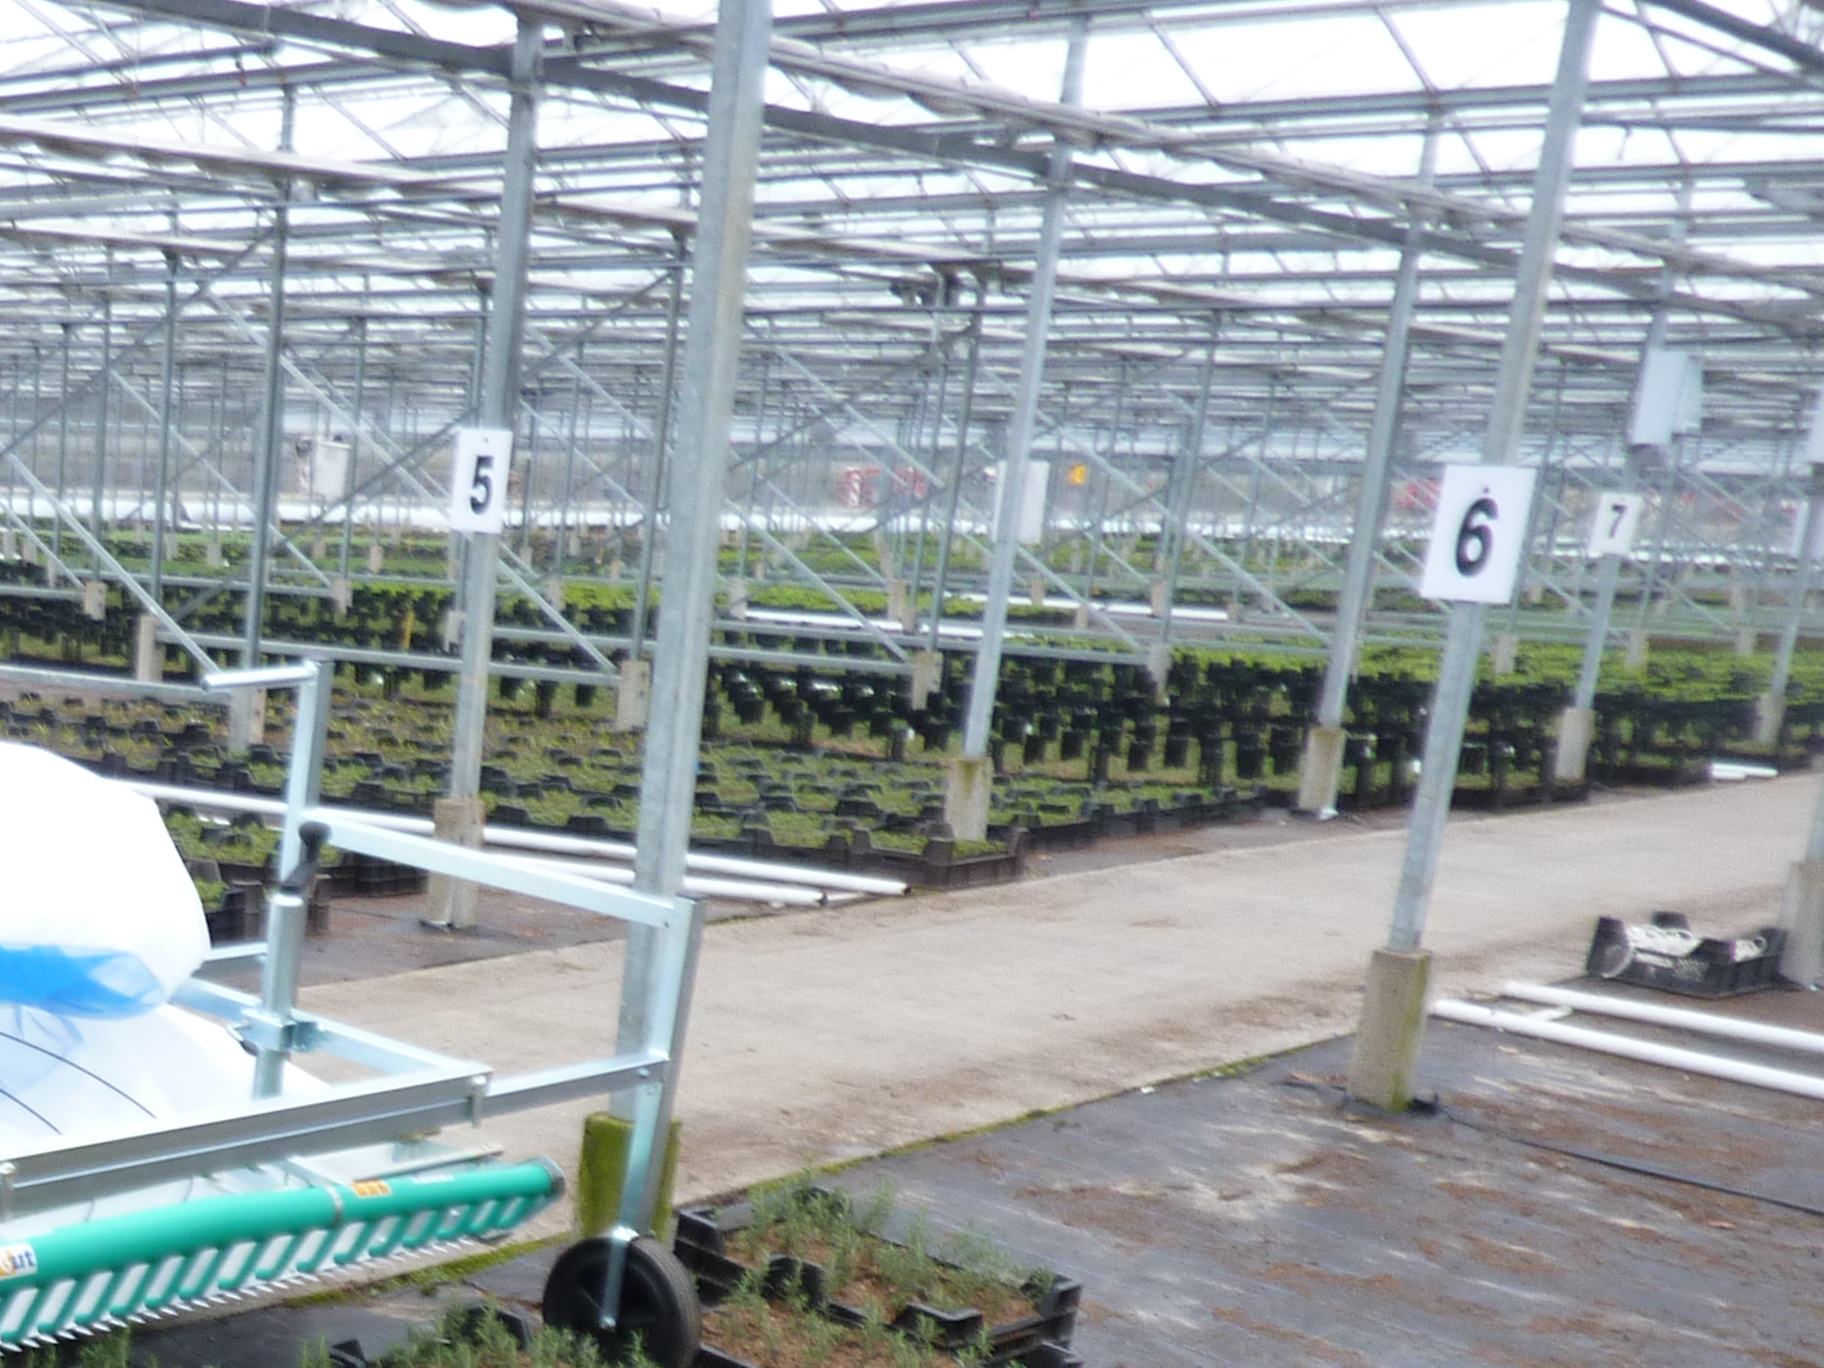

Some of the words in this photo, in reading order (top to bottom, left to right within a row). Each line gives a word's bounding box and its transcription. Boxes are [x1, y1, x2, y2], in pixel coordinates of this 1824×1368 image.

[470, 455, 494, 515] 5
[1455, 497, 1498, 577] 6
[1610, 504, 1627, 539] 7
